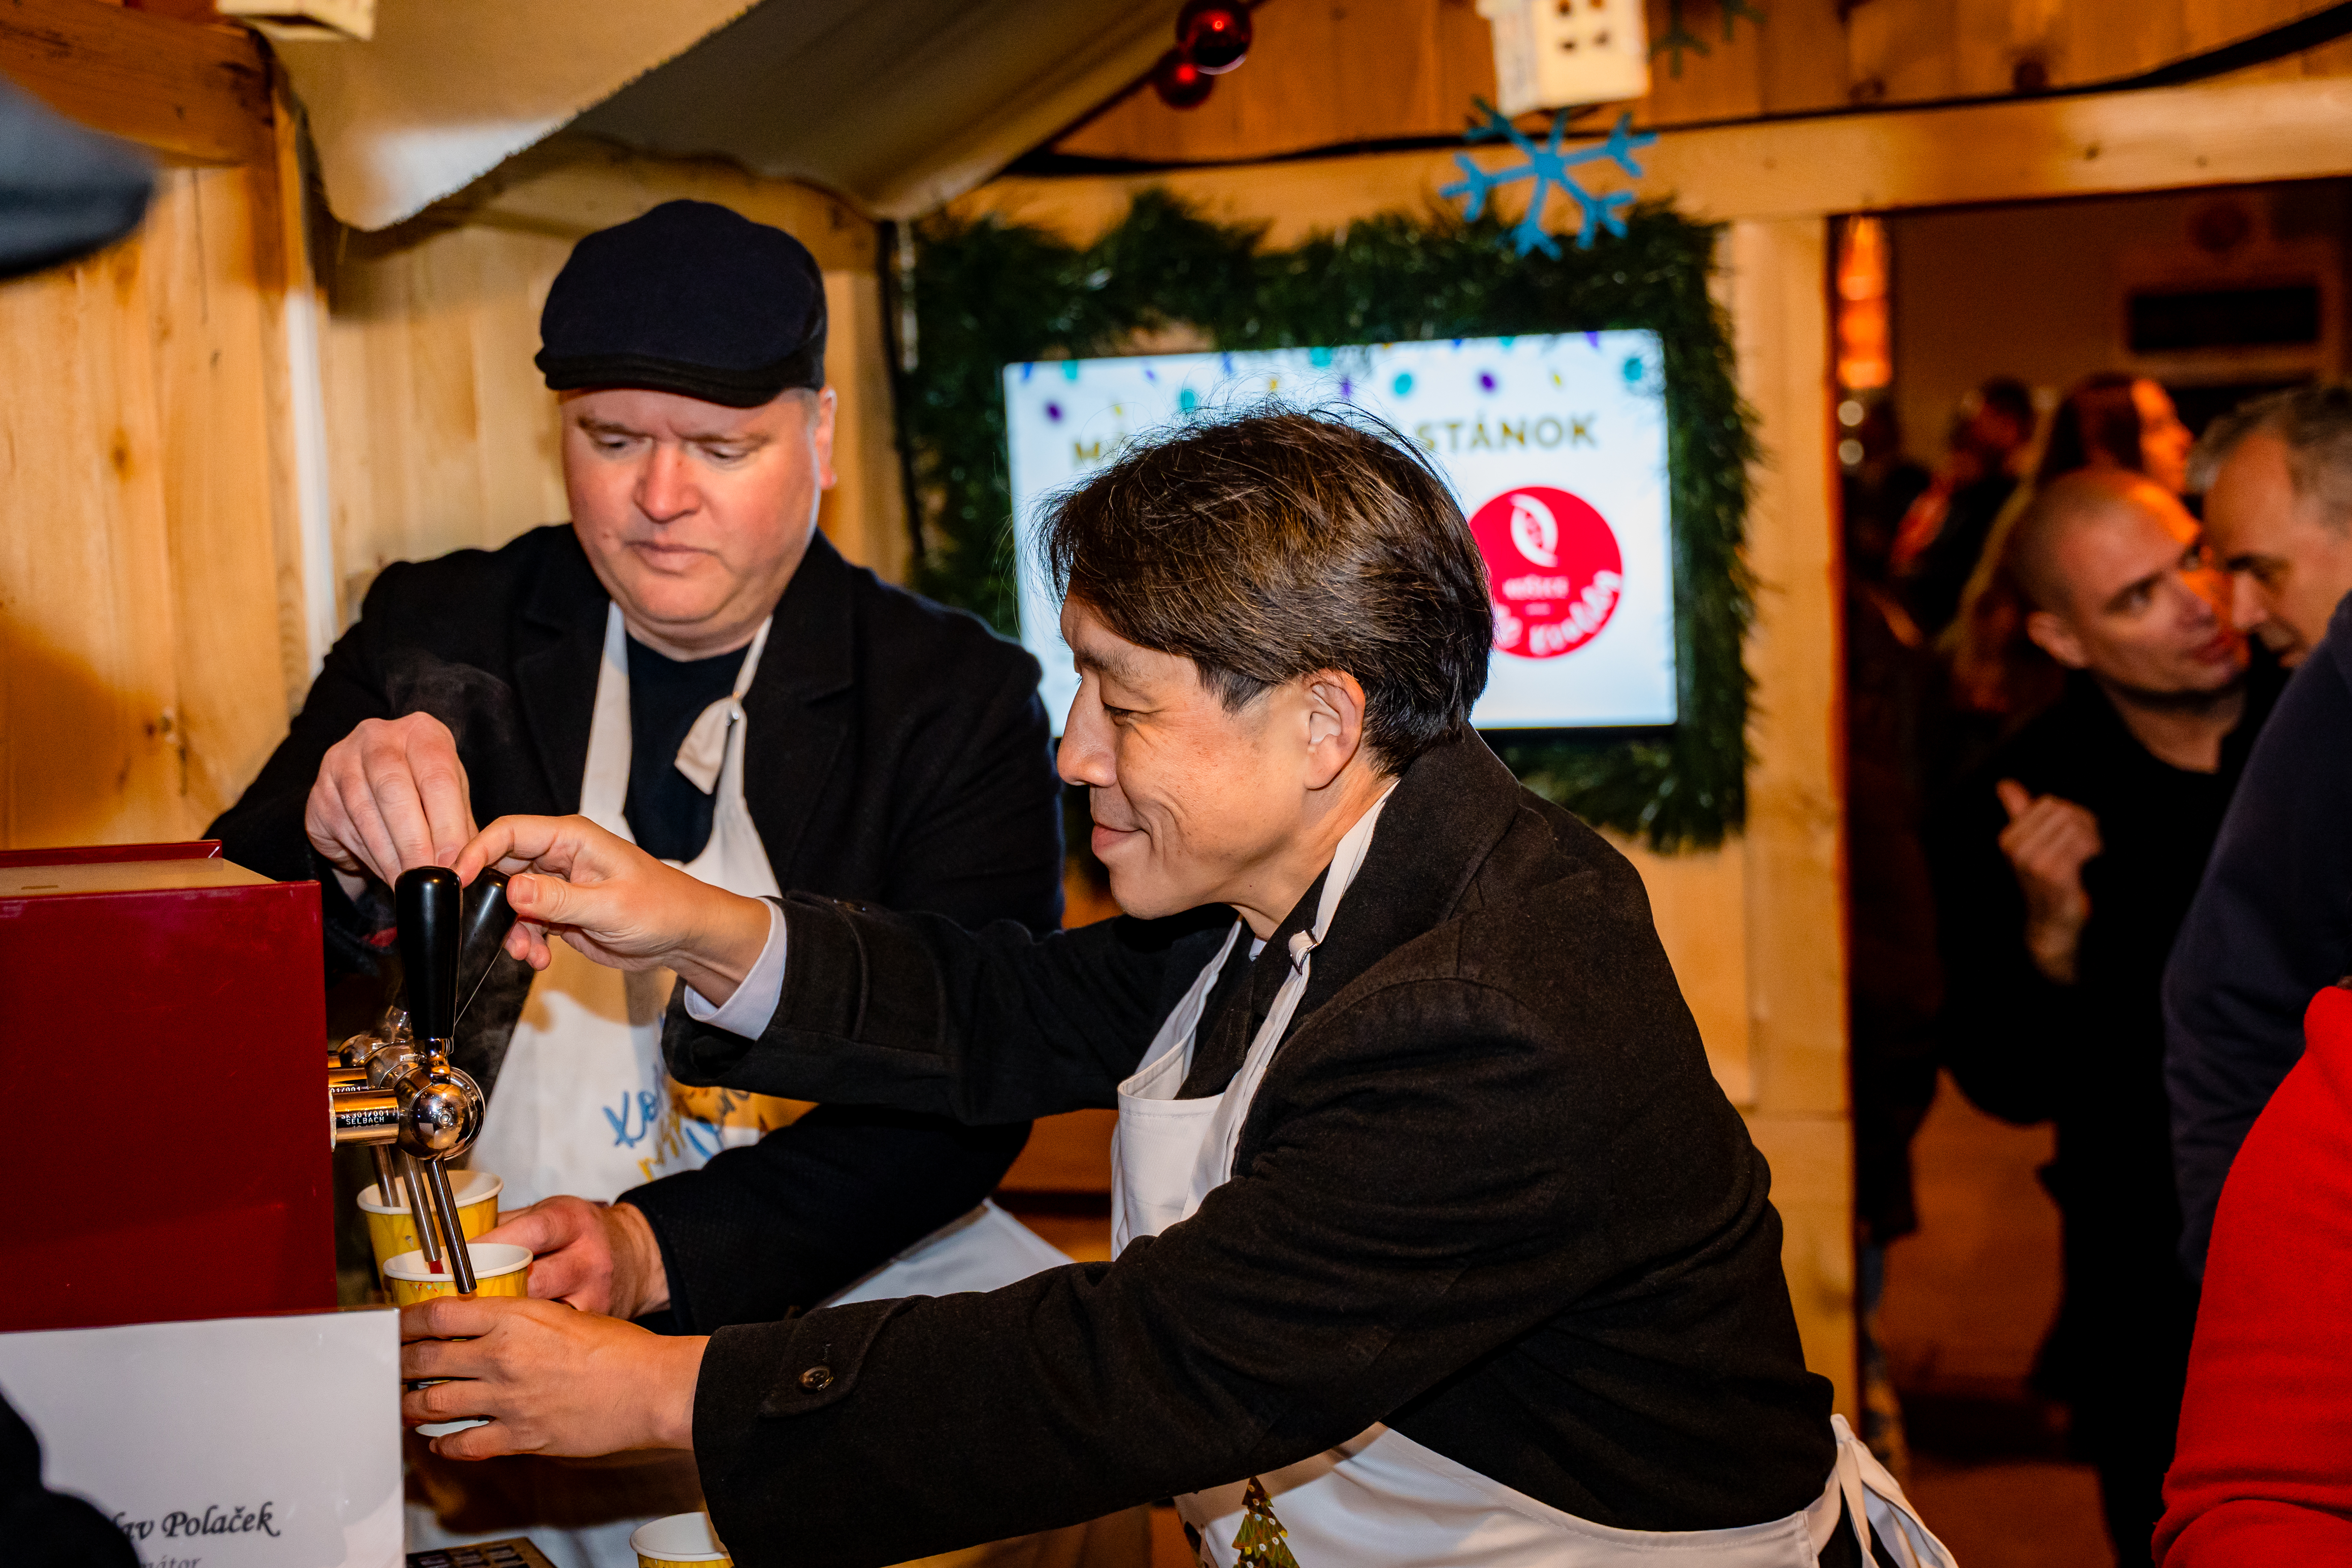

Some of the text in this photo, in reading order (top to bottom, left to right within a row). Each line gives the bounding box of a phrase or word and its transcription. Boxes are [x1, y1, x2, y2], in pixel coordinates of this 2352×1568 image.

[1415, 409, 1597, 452] STÁNOK
[346, 1116, 384, 1125] SELBACH
[161, 1500, 281, 1538] Polaček
